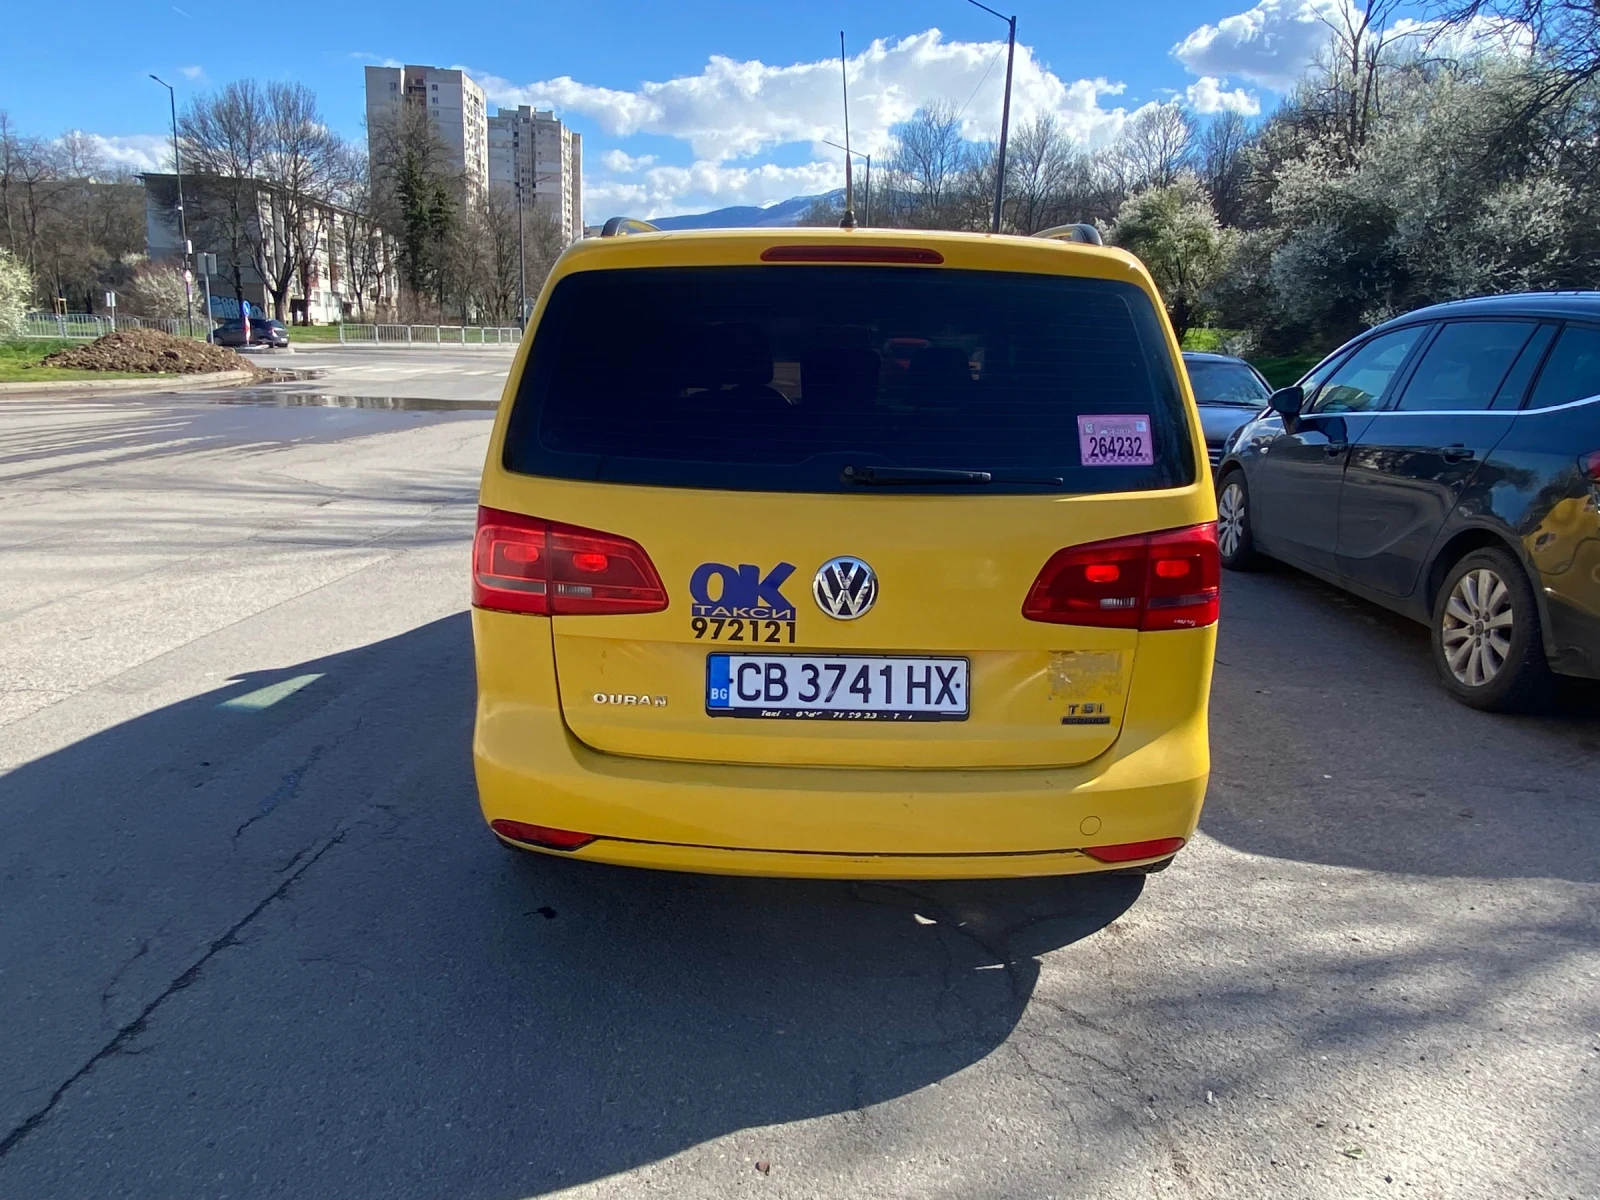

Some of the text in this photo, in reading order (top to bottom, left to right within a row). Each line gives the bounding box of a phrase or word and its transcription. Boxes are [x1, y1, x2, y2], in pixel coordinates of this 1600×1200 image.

[1089, 436, 1143, 457] 264232
[689, 561, 797, 608] OK
[694, 604, 791, 619] ТАКСИ
[691, 617, 796, 643] 972121
[711, 687, 728, 700] BG
[798, 664, 893, 704] 3741
